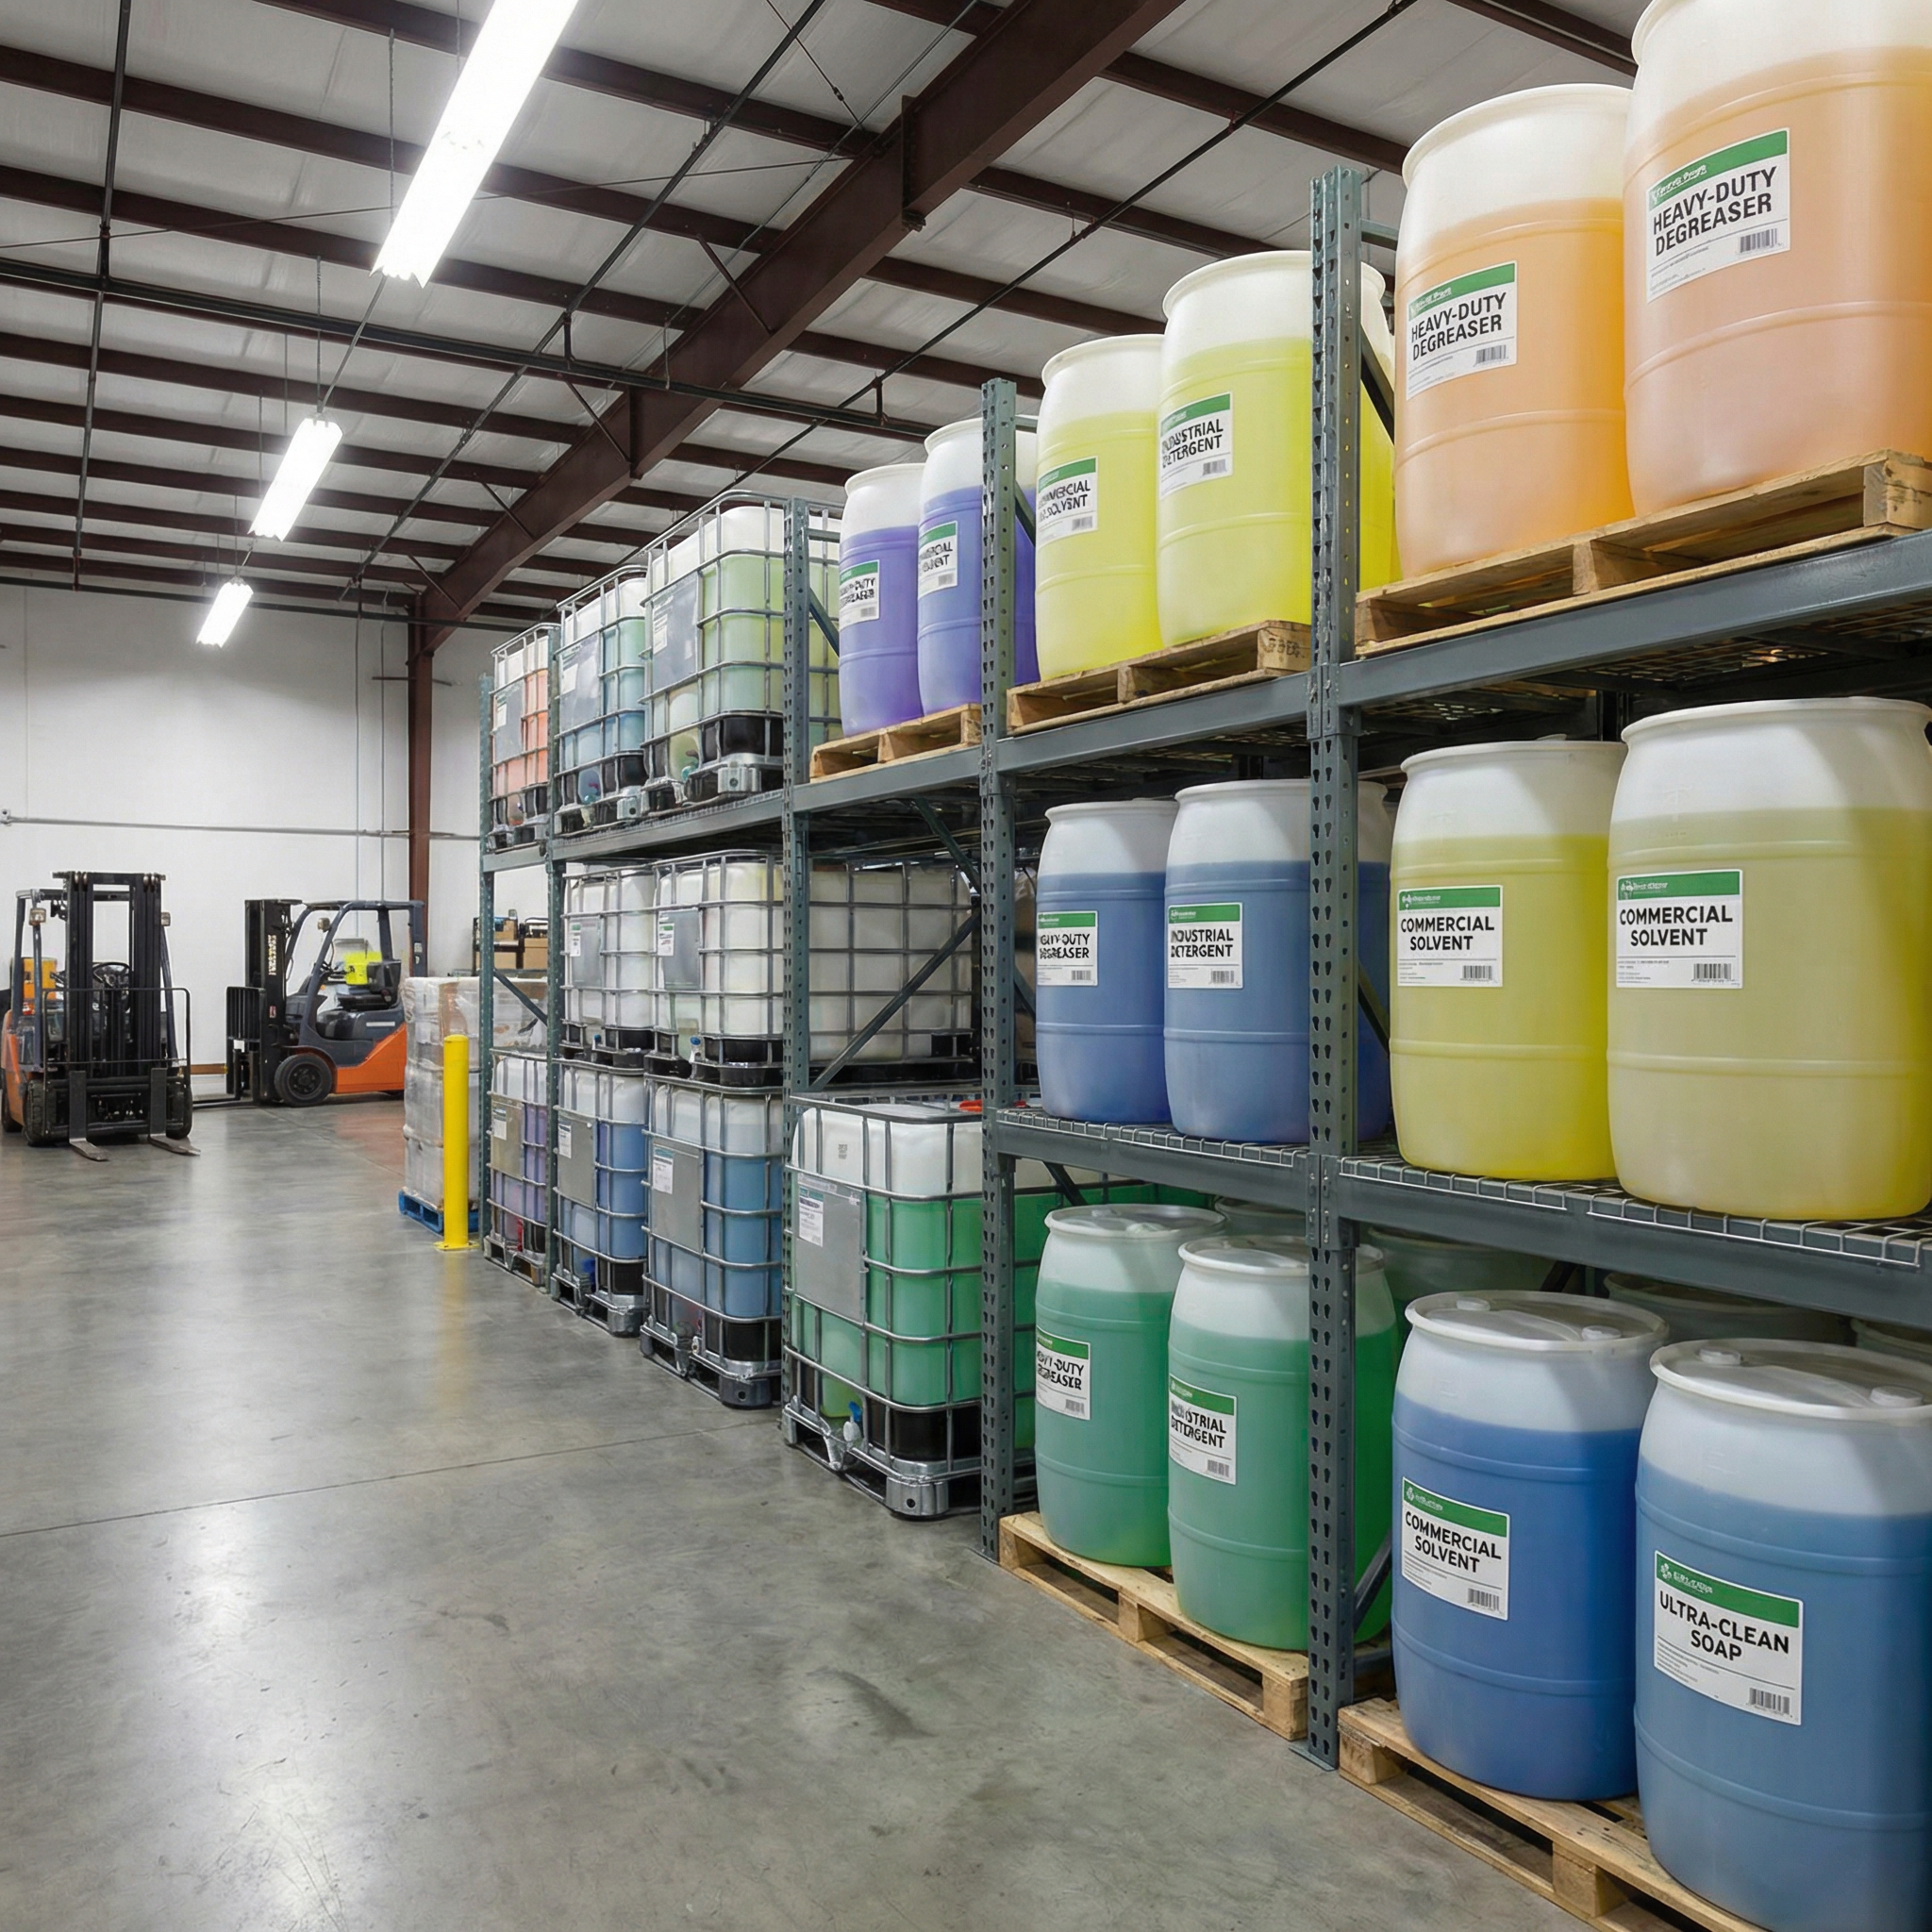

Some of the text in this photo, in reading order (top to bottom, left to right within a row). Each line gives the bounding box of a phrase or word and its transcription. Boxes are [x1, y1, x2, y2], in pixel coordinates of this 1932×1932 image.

[1654, 167, 1776, 235] HEAVY-DUTY
[1656, 192, 1772, 256] DEGREASER
[1412, 292, 1507, 342] HEAVY-DUTY
[1413, 314, 1502, 360] DEGREASER
[1401, 916, 1494, 933] COMMERCIAL
[1620, 906, 1733, 924] COMMERCIAL
[1410, 936, 1474, 951] SOLVENT
[1630, 927, 1707, 947] SOLVENT
[1406, 1510, 1502, 1560] COMMERCIAL
[1415, 1537, 1480, 1574] SOLVENT
[1659, 1591, 1790, 1654] ULTRA-CLEAN
[1690, 1630, 1742, 1661] SOAP
